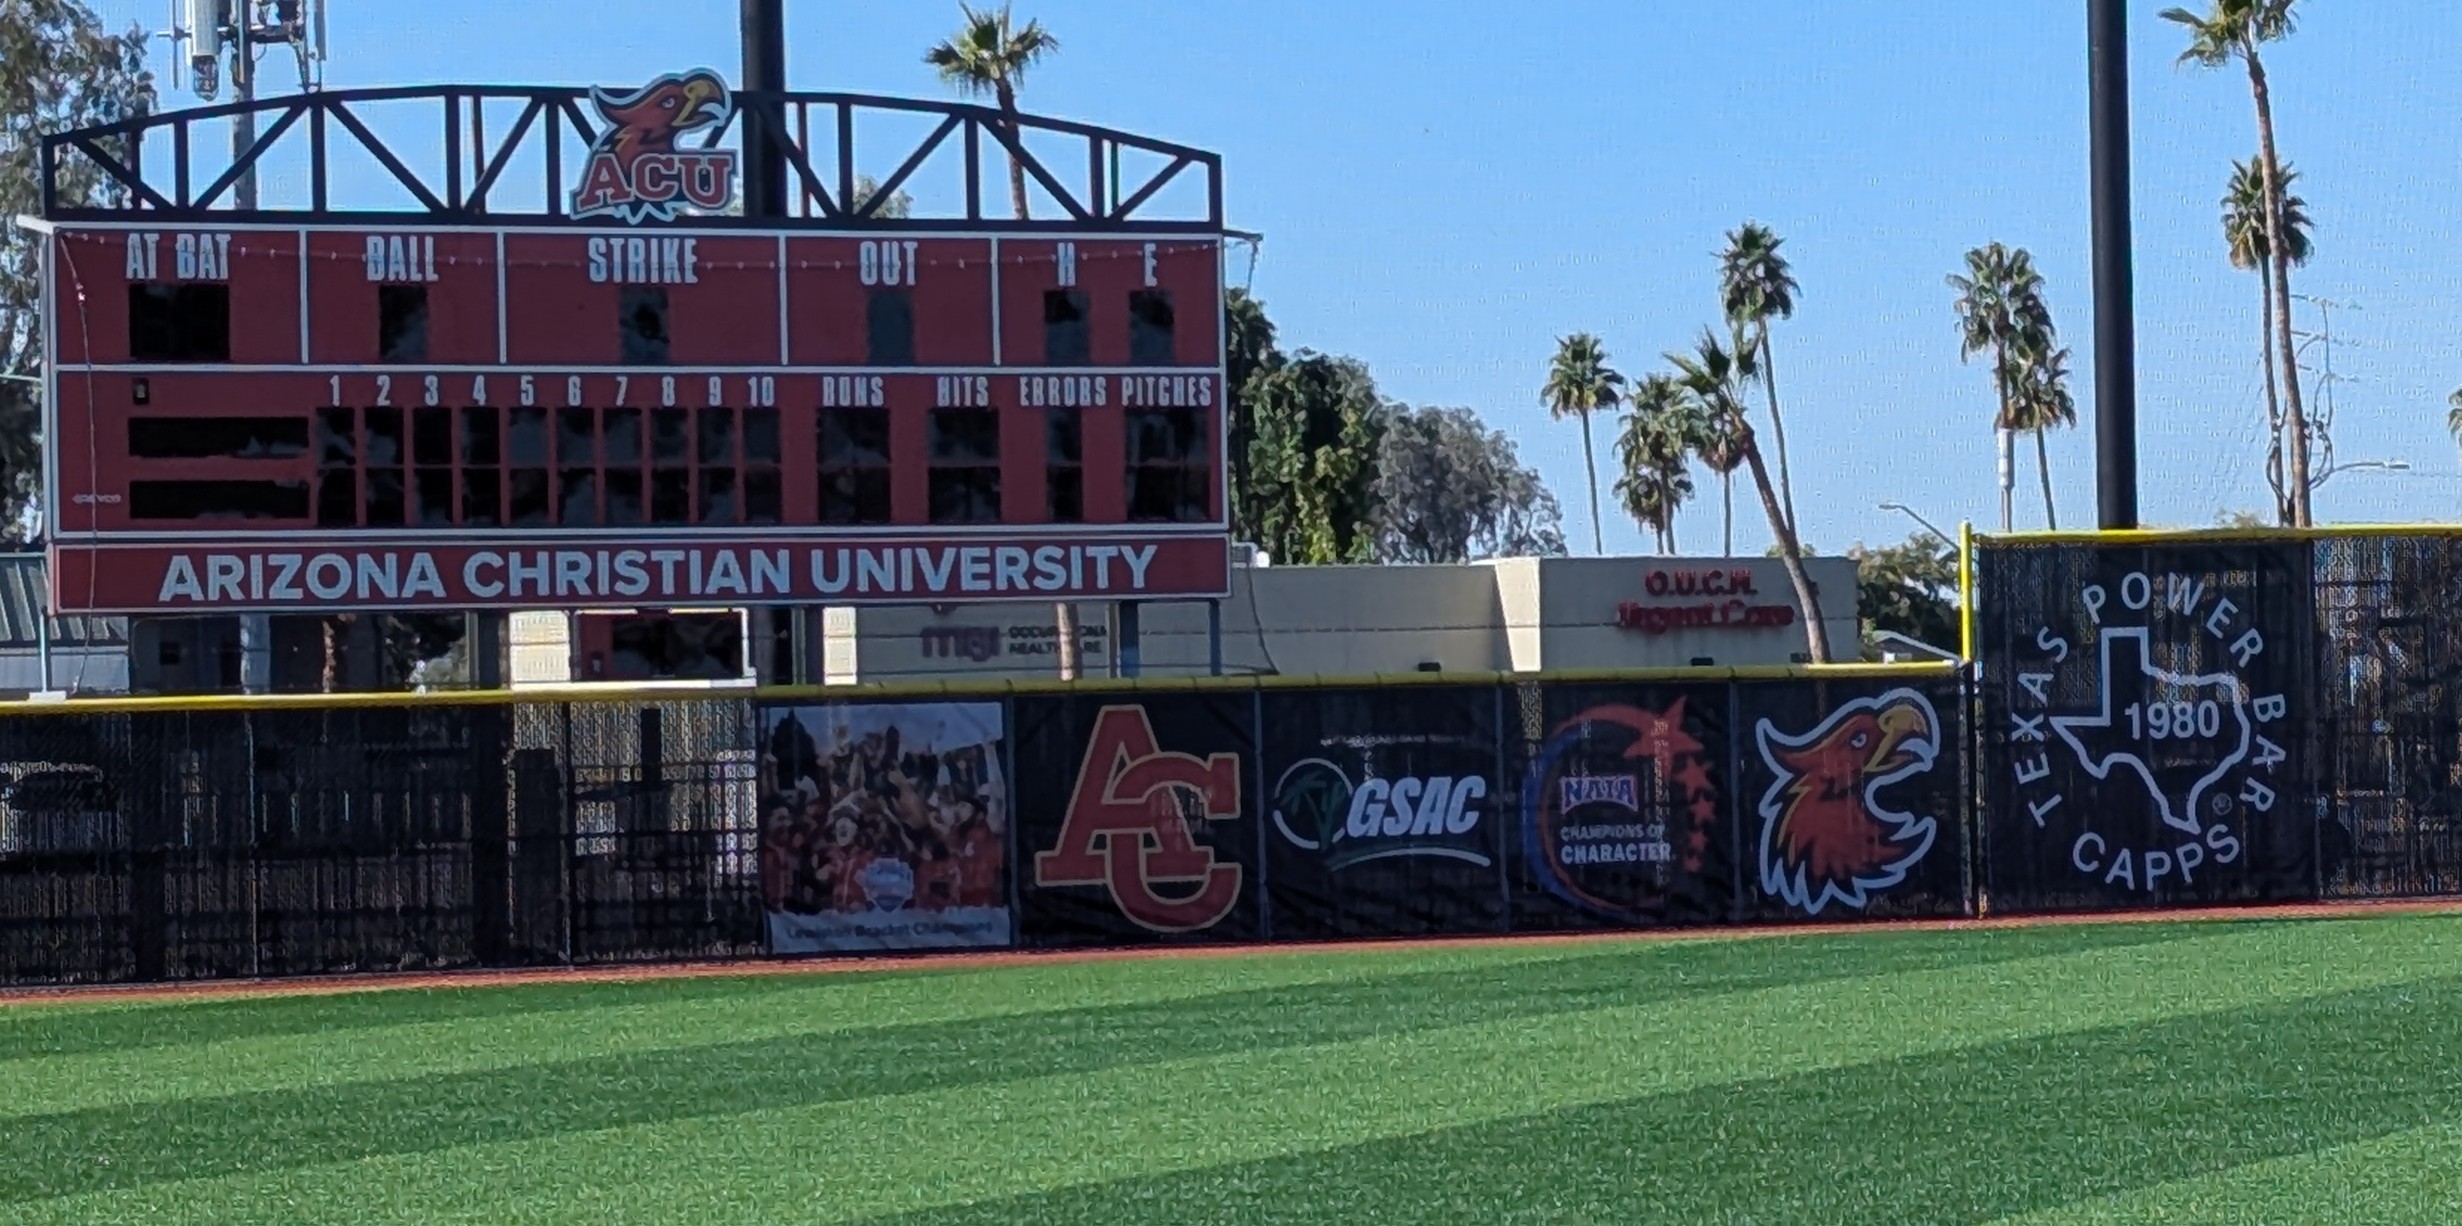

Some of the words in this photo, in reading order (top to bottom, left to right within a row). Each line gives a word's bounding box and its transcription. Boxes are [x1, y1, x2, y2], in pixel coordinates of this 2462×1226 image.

[576, 152, 735, 208] ACU
[126, 234, 160, 280] AT
[177, 234, 231, 280] BAT
[366, 236, 439, 282] BALL
[588, 238, 698, 284] STRIKE
[859, 241, 918, 286] OUT
[1057, 242, 1077, 287] H
[1144, 243, 1159, 288] E
[330, 375, 341, 407] 1
[377, 375, 391, 407] 2
[425, 375, 439, 407] 3
[473, 375, 486, 407] 4
[520, 375, 535, 407] 5
[568, 375, 582, 407] 6
[616, 375, 629, 407] 7
[662, 376, 676, 407] 8
[709, 376, 722, 407] 9
[748, 376, 775, 407] 10
[822, 376, 885, 407] RUNS
[937, 376, 989, 407] HITS
[1019, 376, 1107, 407] ERRORS
[1121, 376, 1212, 407] PITCHES
[159, 552, 447, 601] ARIZONA
[462, 547, 791, 598] CHRISTIAN
[811, 544, 1158, 593] UNIVERSITY
[2010, 625, 2069, 829] TEXAS
[2082, 571, 2264, 669] POWER
[2238, 693, 2286, 813] BAR
[2124, 700, 2220, 740] 1980
[1347, 775, 1486, 838] GSAC
[1560, 824, 1645, 841] CHAMPIONS
[1646, 823, 1666, 839] OF
[1561, 843, 1672, 864] CHARACTER
[2073, 824, 2240, 891] CAPPS
